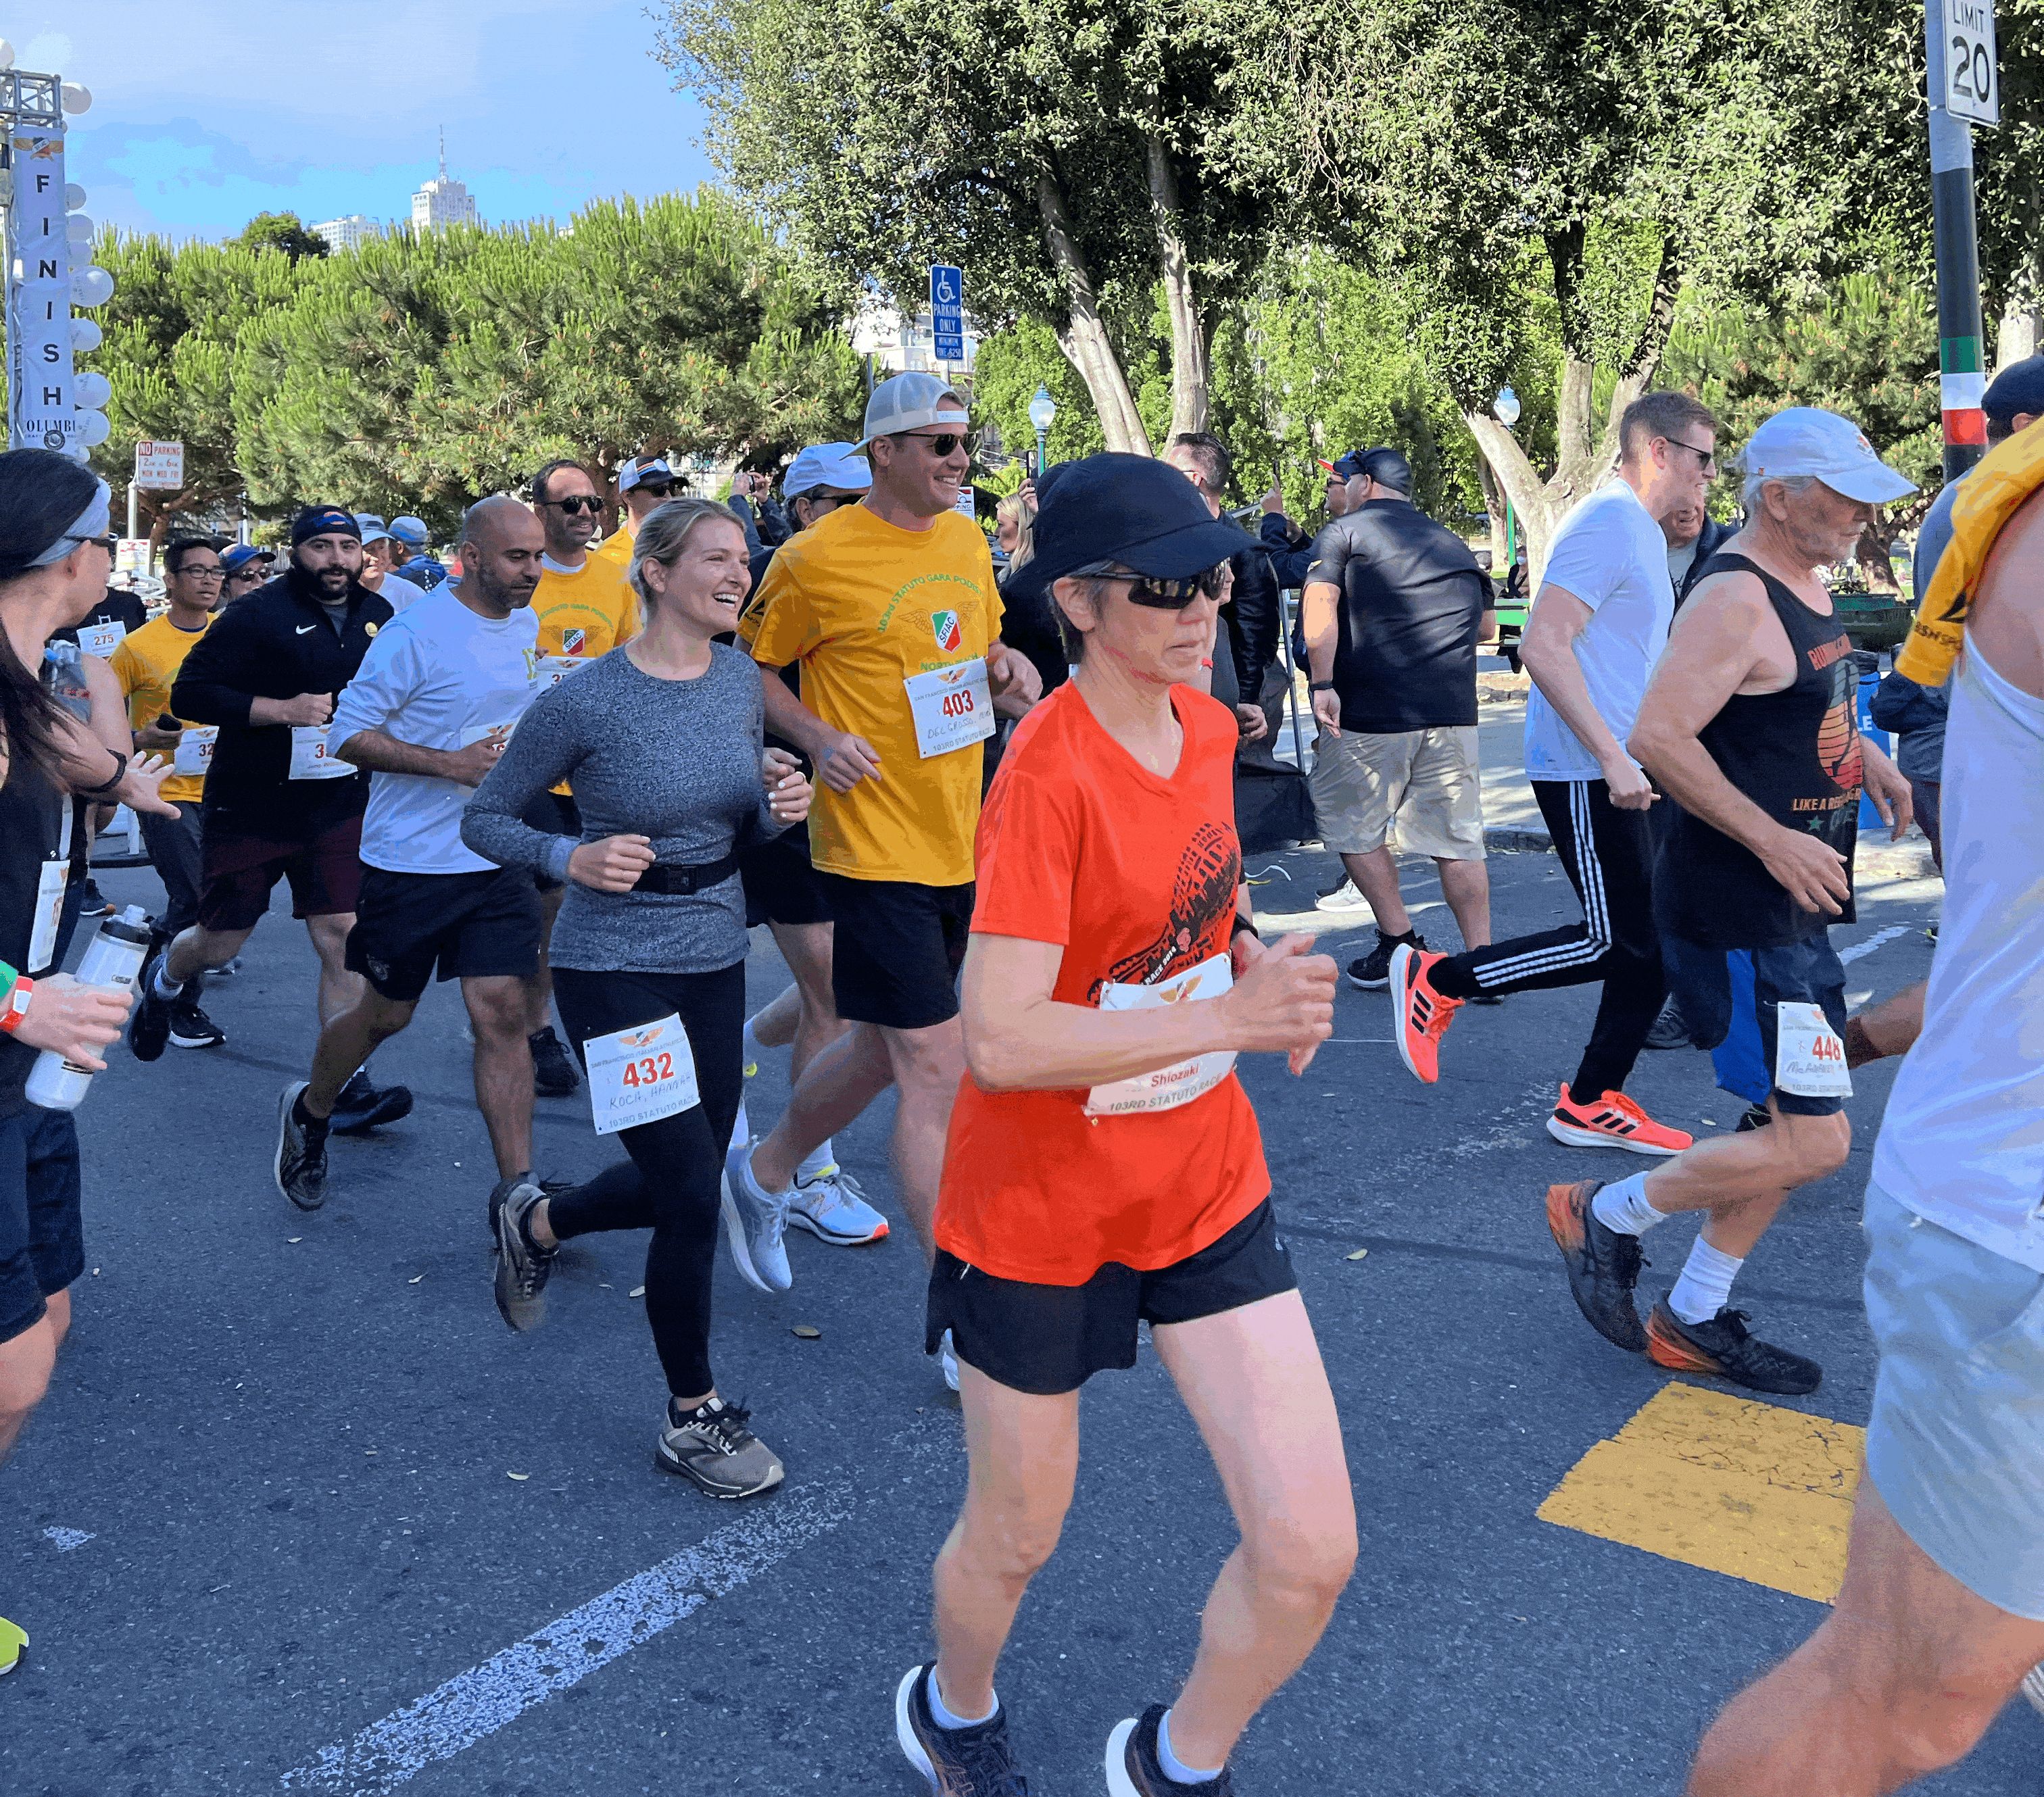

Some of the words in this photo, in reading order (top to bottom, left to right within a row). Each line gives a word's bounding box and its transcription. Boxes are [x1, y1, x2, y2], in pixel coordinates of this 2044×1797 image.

[1953, 0, 1984, 33] LIMIT
[1952, 36, 1990, 103] 20
[36, 174, 62, 405] FINISH
[933, 303, 960, 318] PARKING
[939, 318, 956, 333] ONLY
[936, 347, 947, 357] FINE
[139, 443, 152, 456] NO
[154, 446, 181, 456] PARKING
[891, 576, 926, 604] STATUTO
[927, 574, 952, 582] GARA
[94, 634, 114, 645] 275
[565, 633, 582, 649] SFIAC
[939, 616, 954, 643] SFIAC
[942, 689, 974, 718] 403
[1793, 798, 1819, 811] LIKE
[1818, 798, 1826, 811] A
[1144, 964, 1163, 985] RACE
[623, 1052, 674, 1087] 432
[609, 1114, 635, 1128] 103RD
[638, 1104, 677, 1120] STATUTO
[678, 1096, 695, 1107] RACE
[1110, 1100, 1146, 1112] 103RD
[1148, 1085, 1197, 1108] STATUTO
